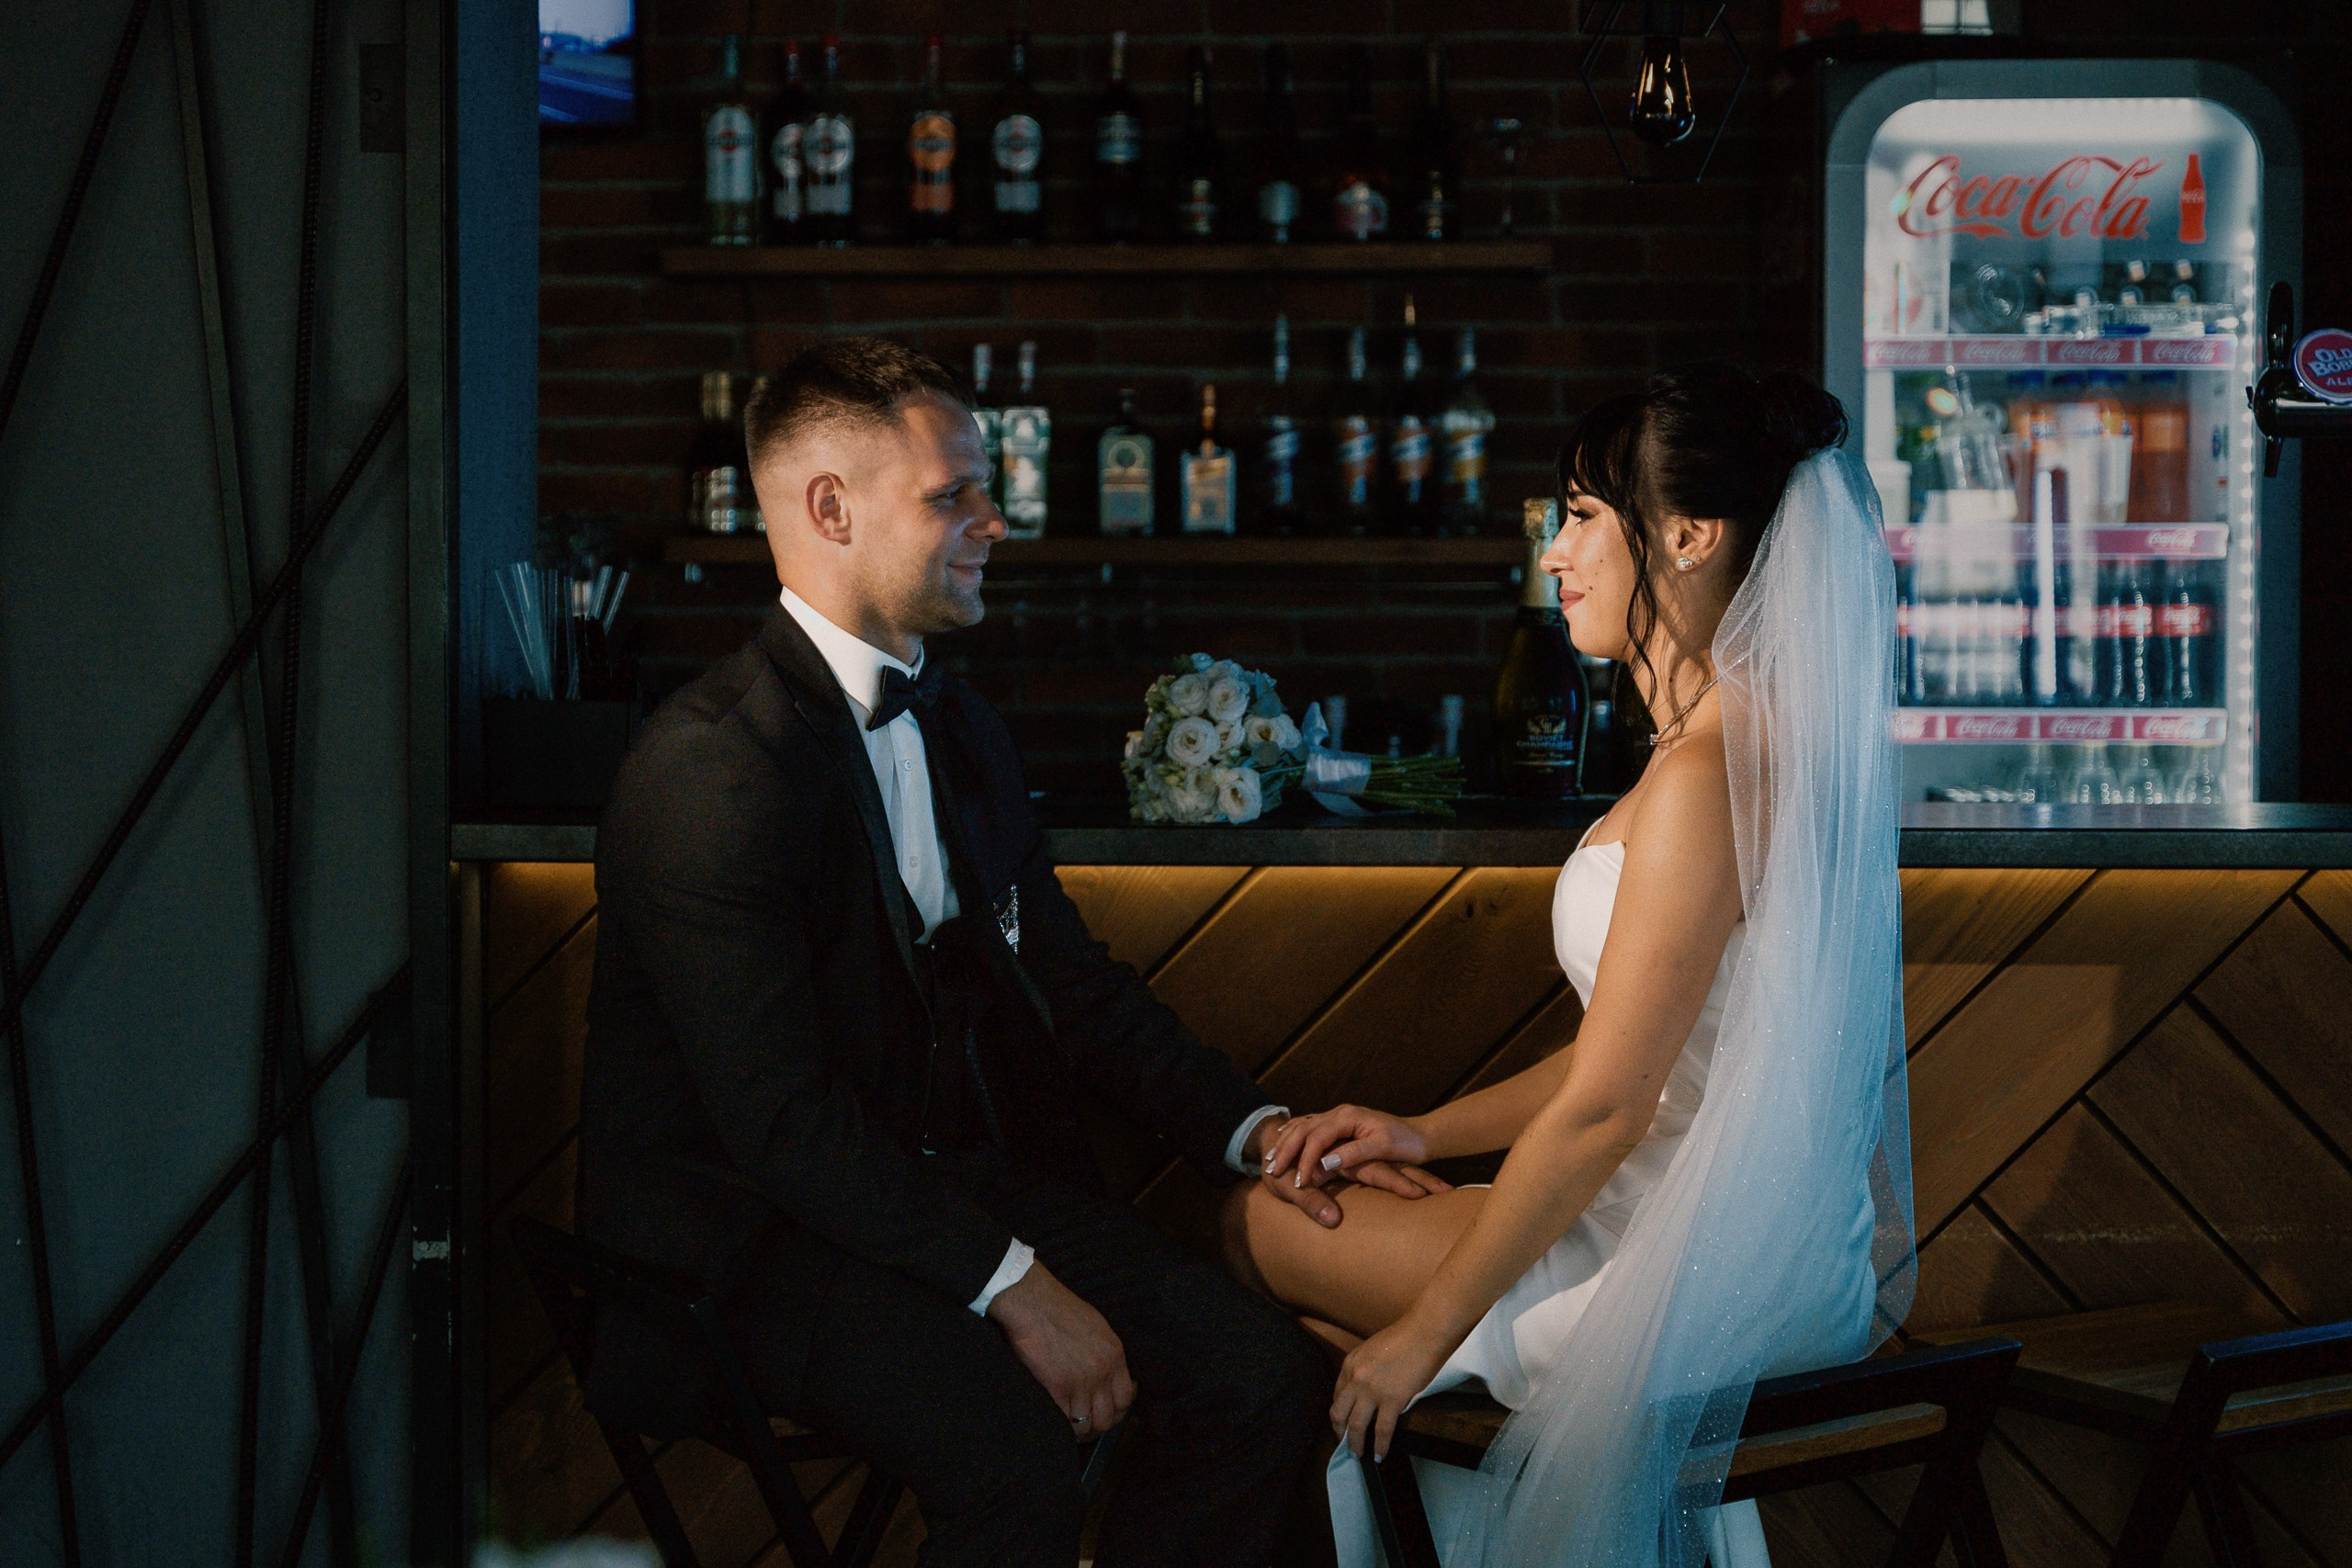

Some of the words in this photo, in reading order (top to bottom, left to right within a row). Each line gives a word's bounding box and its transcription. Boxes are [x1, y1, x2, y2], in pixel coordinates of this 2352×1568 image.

[1897, 153, 2165, 240] Coca-Cola
[2314, 348, 2352, 364] OLD
[2307, 359, 2352, 378] BOB
